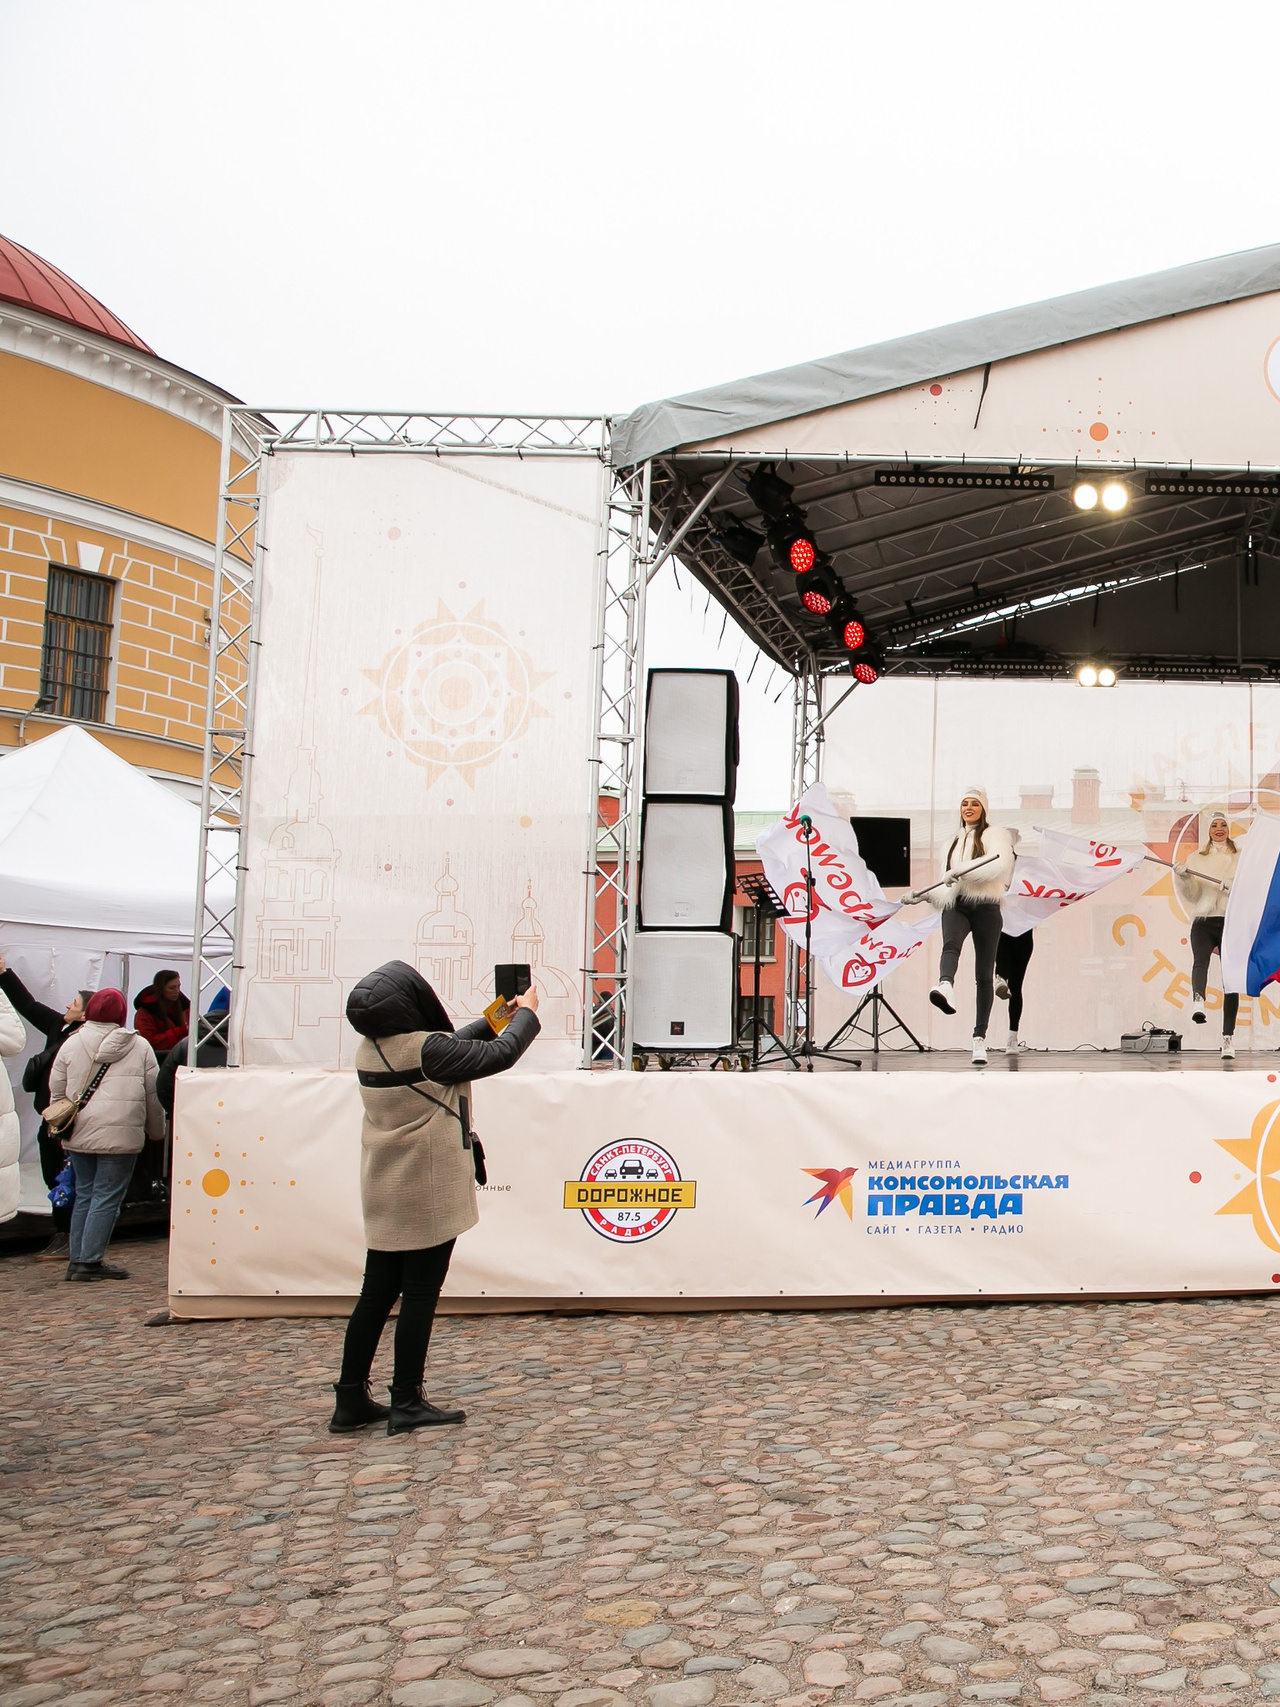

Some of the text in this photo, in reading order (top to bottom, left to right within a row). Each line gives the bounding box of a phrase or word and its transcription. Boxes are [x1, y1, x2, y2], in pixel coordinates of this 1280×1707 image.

[590, 1145, 672, 1176] САНКТ-ПЕТЕРБУРГ
[868, 1160, 961, 1170] МЕДИАГРУППА
[868, 1174, 1069, 1190] КОМСОМОЛЬСКАЯ
[867, 1193, 1023, 1219] ПРАВДА
[617, 1212, 641, 1221] 87.5
[599, 1218, 659, 1237] РАДИО
[866, 1223, 1024, 1236] САЙТ ГАЗЕТА РАДИО
